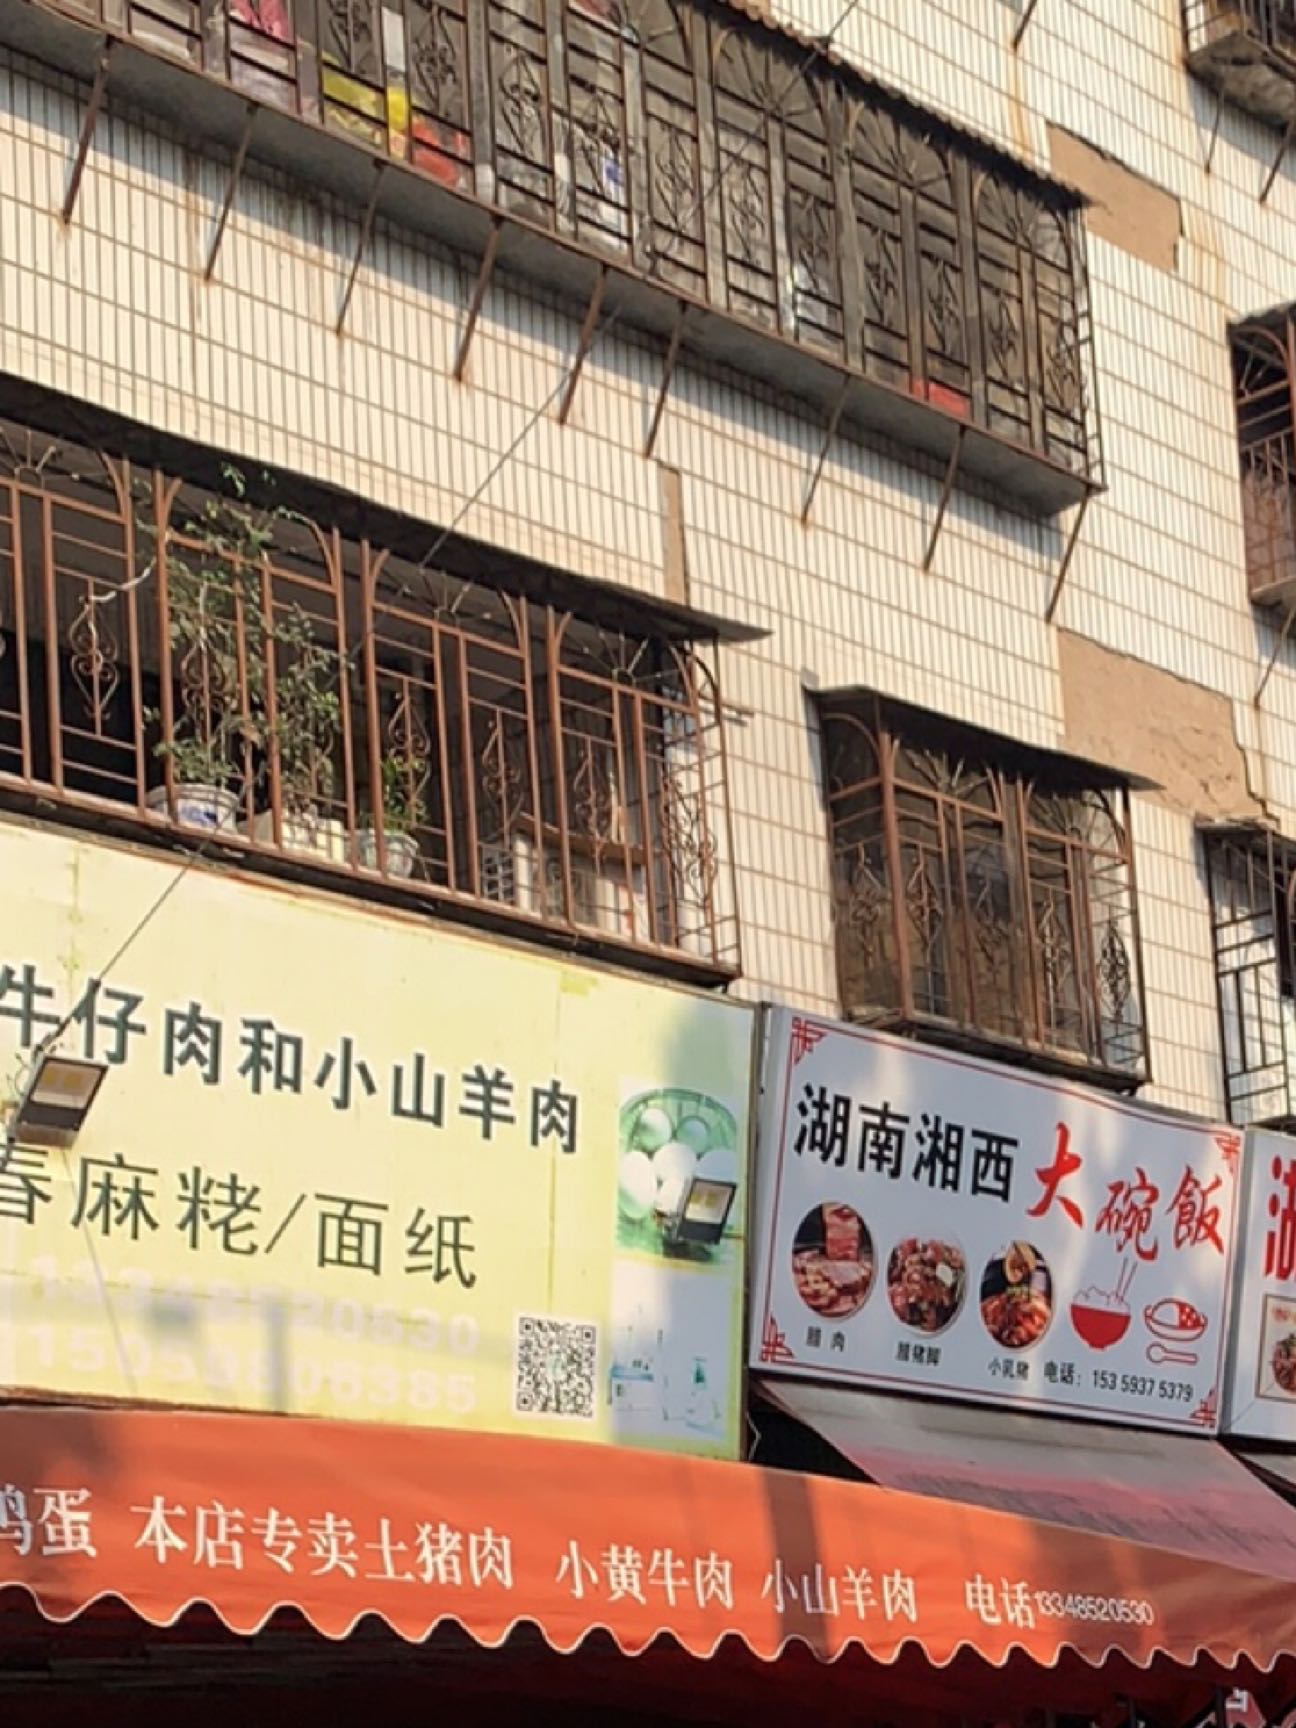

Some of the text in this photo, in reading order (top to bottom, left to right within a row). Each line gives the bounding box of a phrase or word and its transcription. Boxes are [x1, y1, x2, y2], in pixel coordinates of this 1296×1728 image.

[793, 1082, 1020, 1203] 湖南湘西
[129, 1494, 514, 1589] 本店专卖土猪肉
[555, 1540, 734, 1611] 小黄牛肉
[760, 1558, 918, 1622] 小山羊肉
